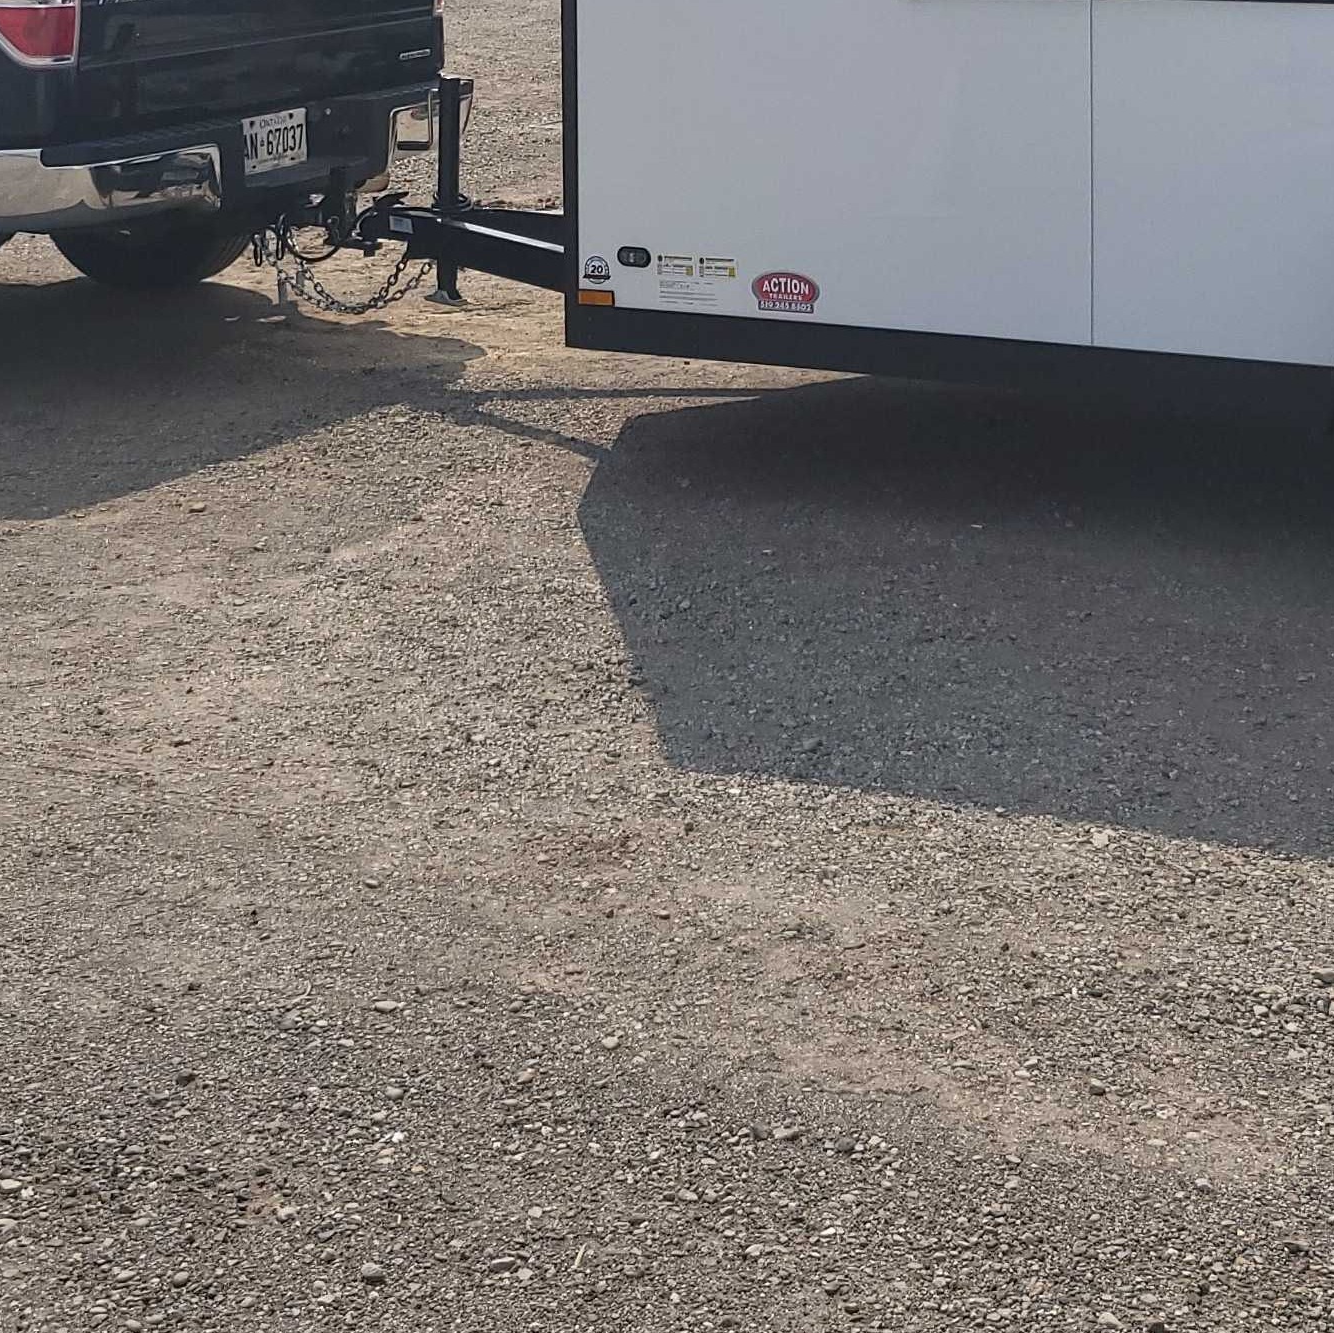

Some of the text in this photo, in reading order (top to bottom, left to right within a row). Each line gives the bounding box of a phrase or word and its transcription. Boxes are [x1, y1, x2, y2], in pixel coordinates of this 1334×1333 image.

[266, 123, 304, 156] 67037
[590, 264, 604, 274] 20
[762, 277, 809, 295] ACTION
